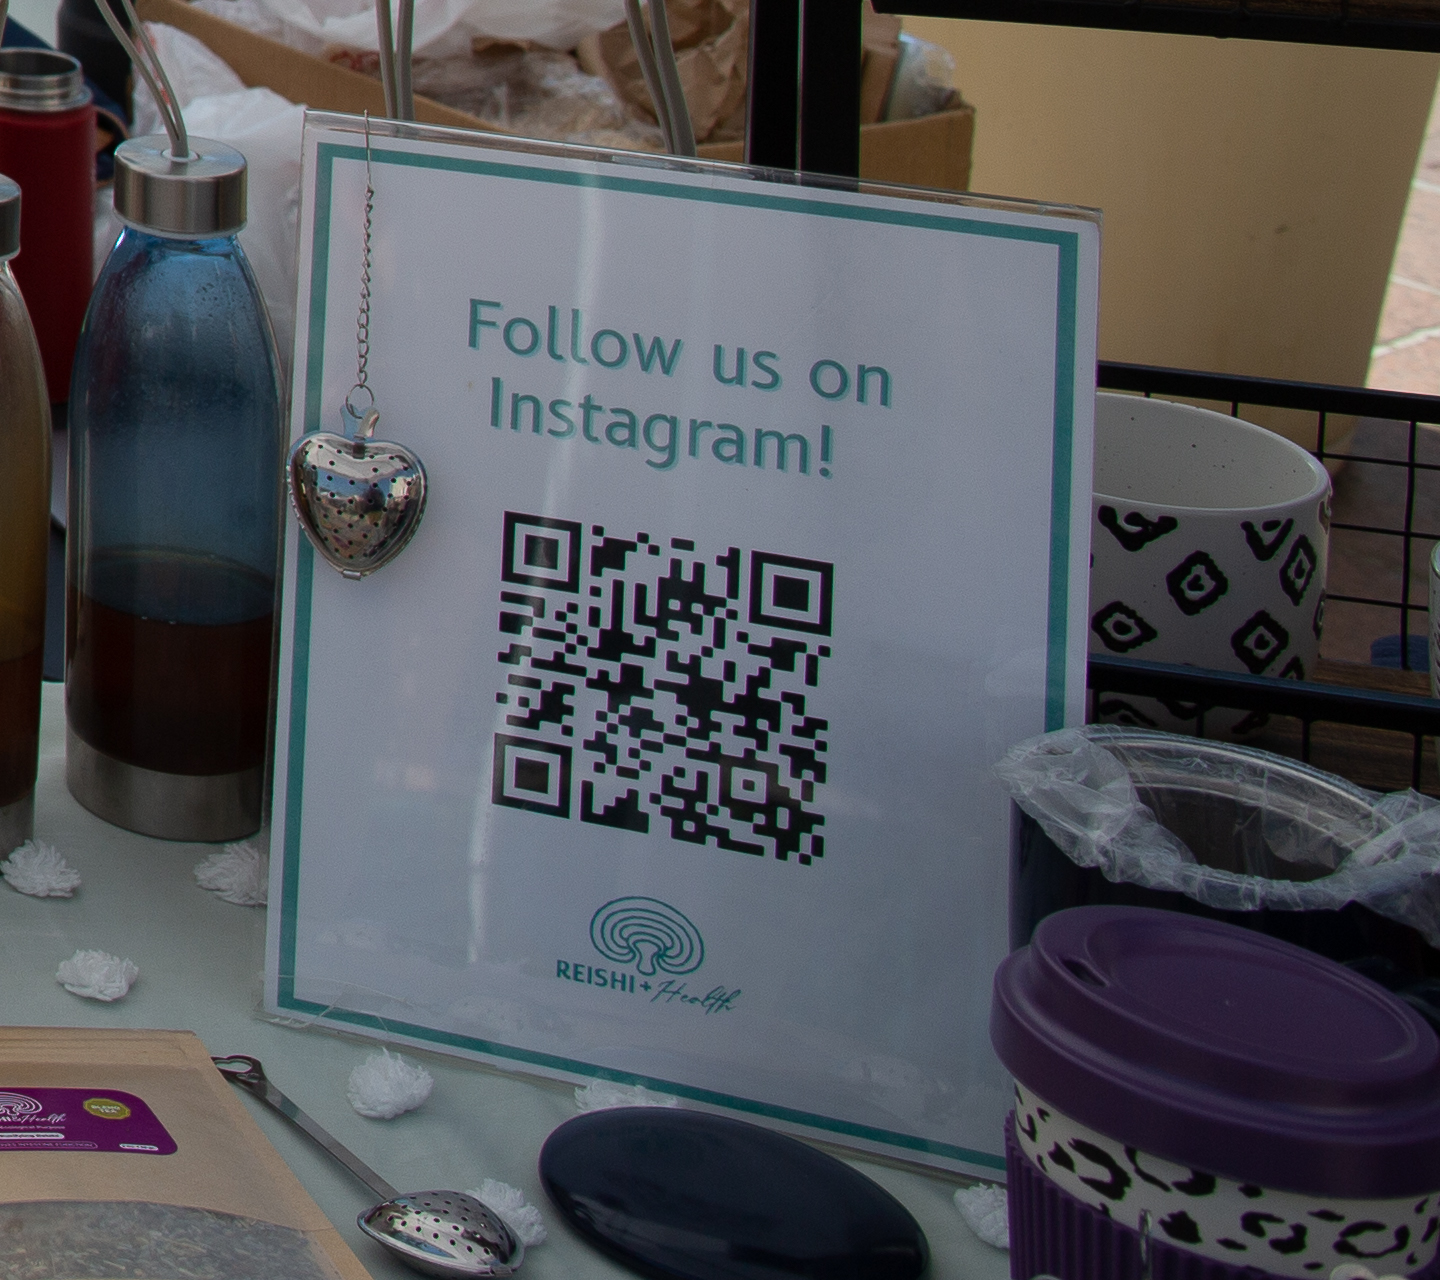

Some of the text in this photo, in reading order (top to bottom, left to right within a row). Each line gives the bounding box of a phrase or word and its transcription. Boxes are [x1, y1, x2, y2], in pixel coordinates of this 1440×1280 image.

[468, 297, 892, 408] Follow us on
[489, 376, 834, 479] Instagram!
